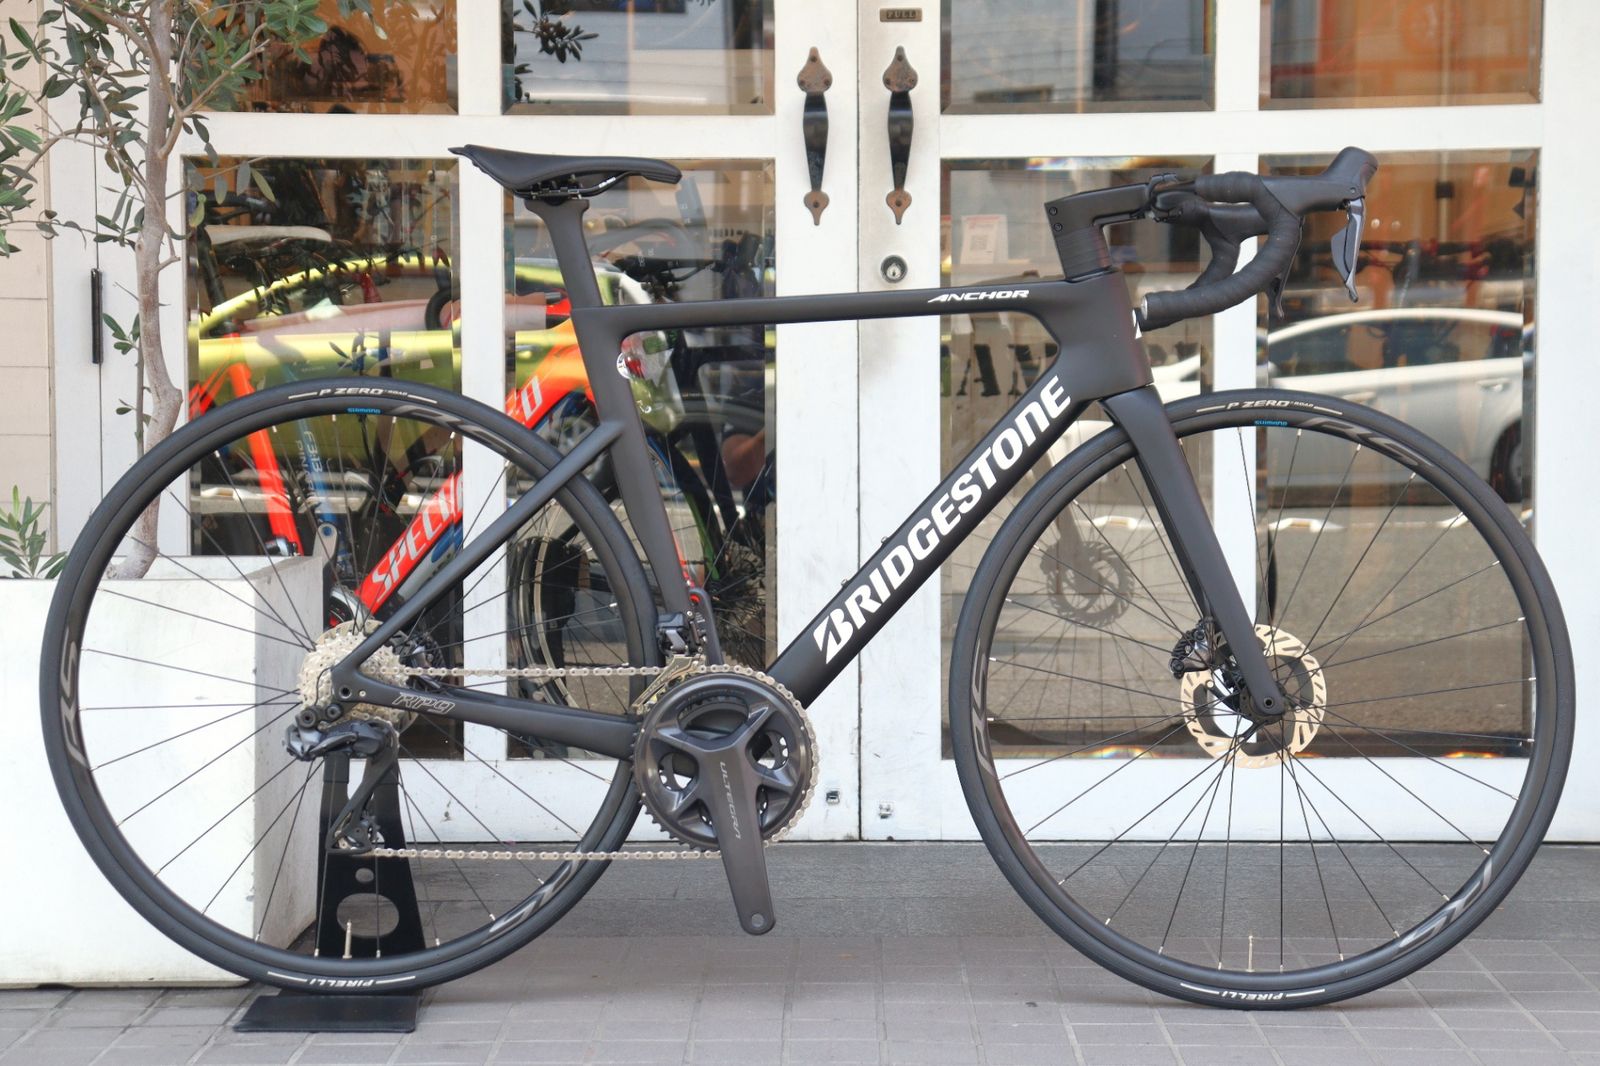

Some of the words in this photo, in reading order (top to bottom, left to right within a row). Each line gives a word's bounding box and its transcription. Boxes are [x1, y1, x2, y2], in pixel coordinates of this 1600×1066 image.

[927, 289, 1030, 303] ANCHOR
[318, 387, 332, 397] P
[334, 387, 384, 396] ZERO
[1227, 401, 1240, 410] P
[1242, 399, 1291, 408] ZERO
[812, 375, 1071, 665] BRIDGESTONE
[719, 761, 741, 840] ULTEGRA
[309, 978, 374, 988] PIRELLI
[1221, 990, 1284, 1001] PIRELLI
